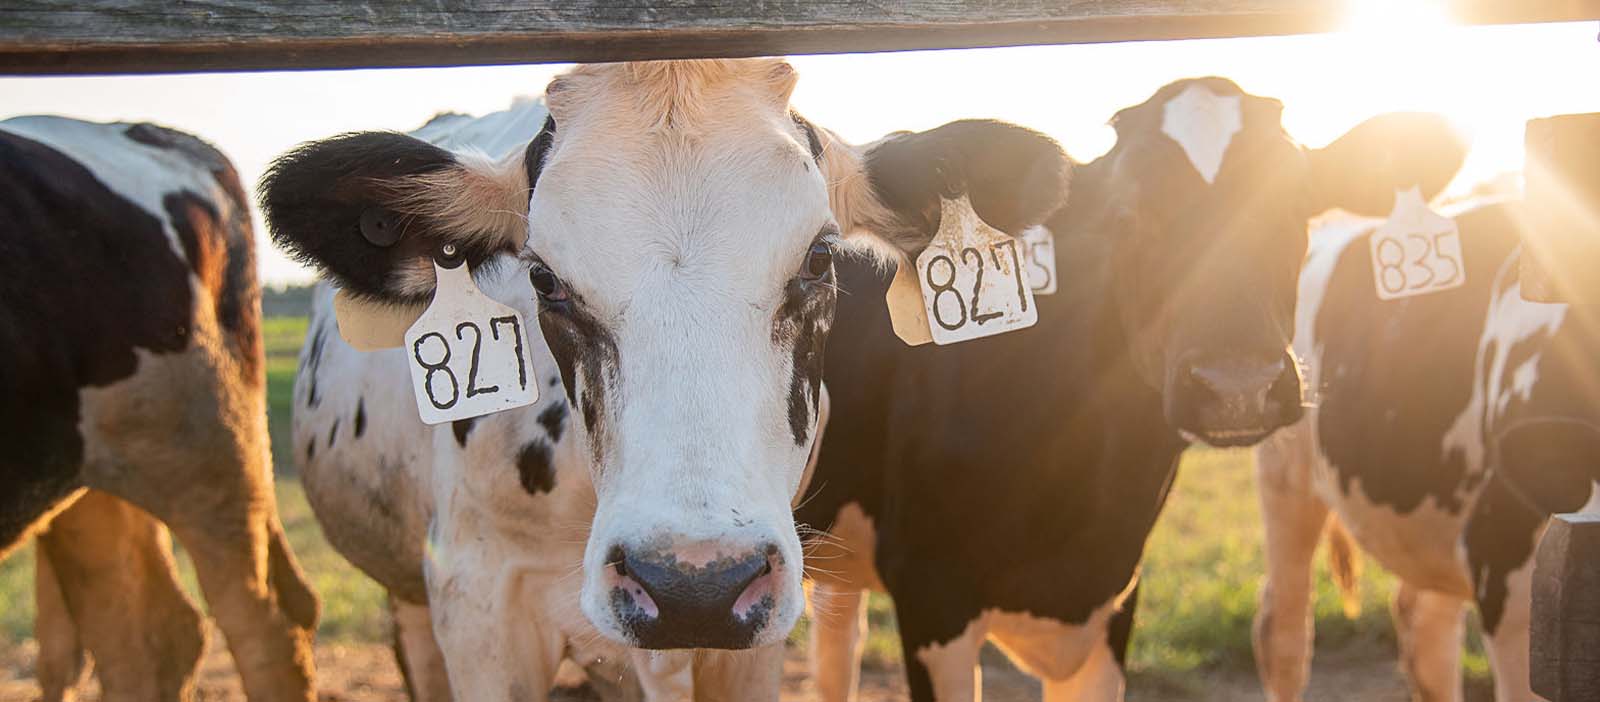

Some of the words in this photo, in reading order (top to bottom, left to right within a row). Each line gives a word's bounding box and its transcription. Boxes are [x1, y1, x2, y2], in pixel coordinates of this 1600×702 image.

[926, 239, 1028, 330] 827
[1377, 230, 1459, 294] 835
[414, 314, 527, 410] 827
